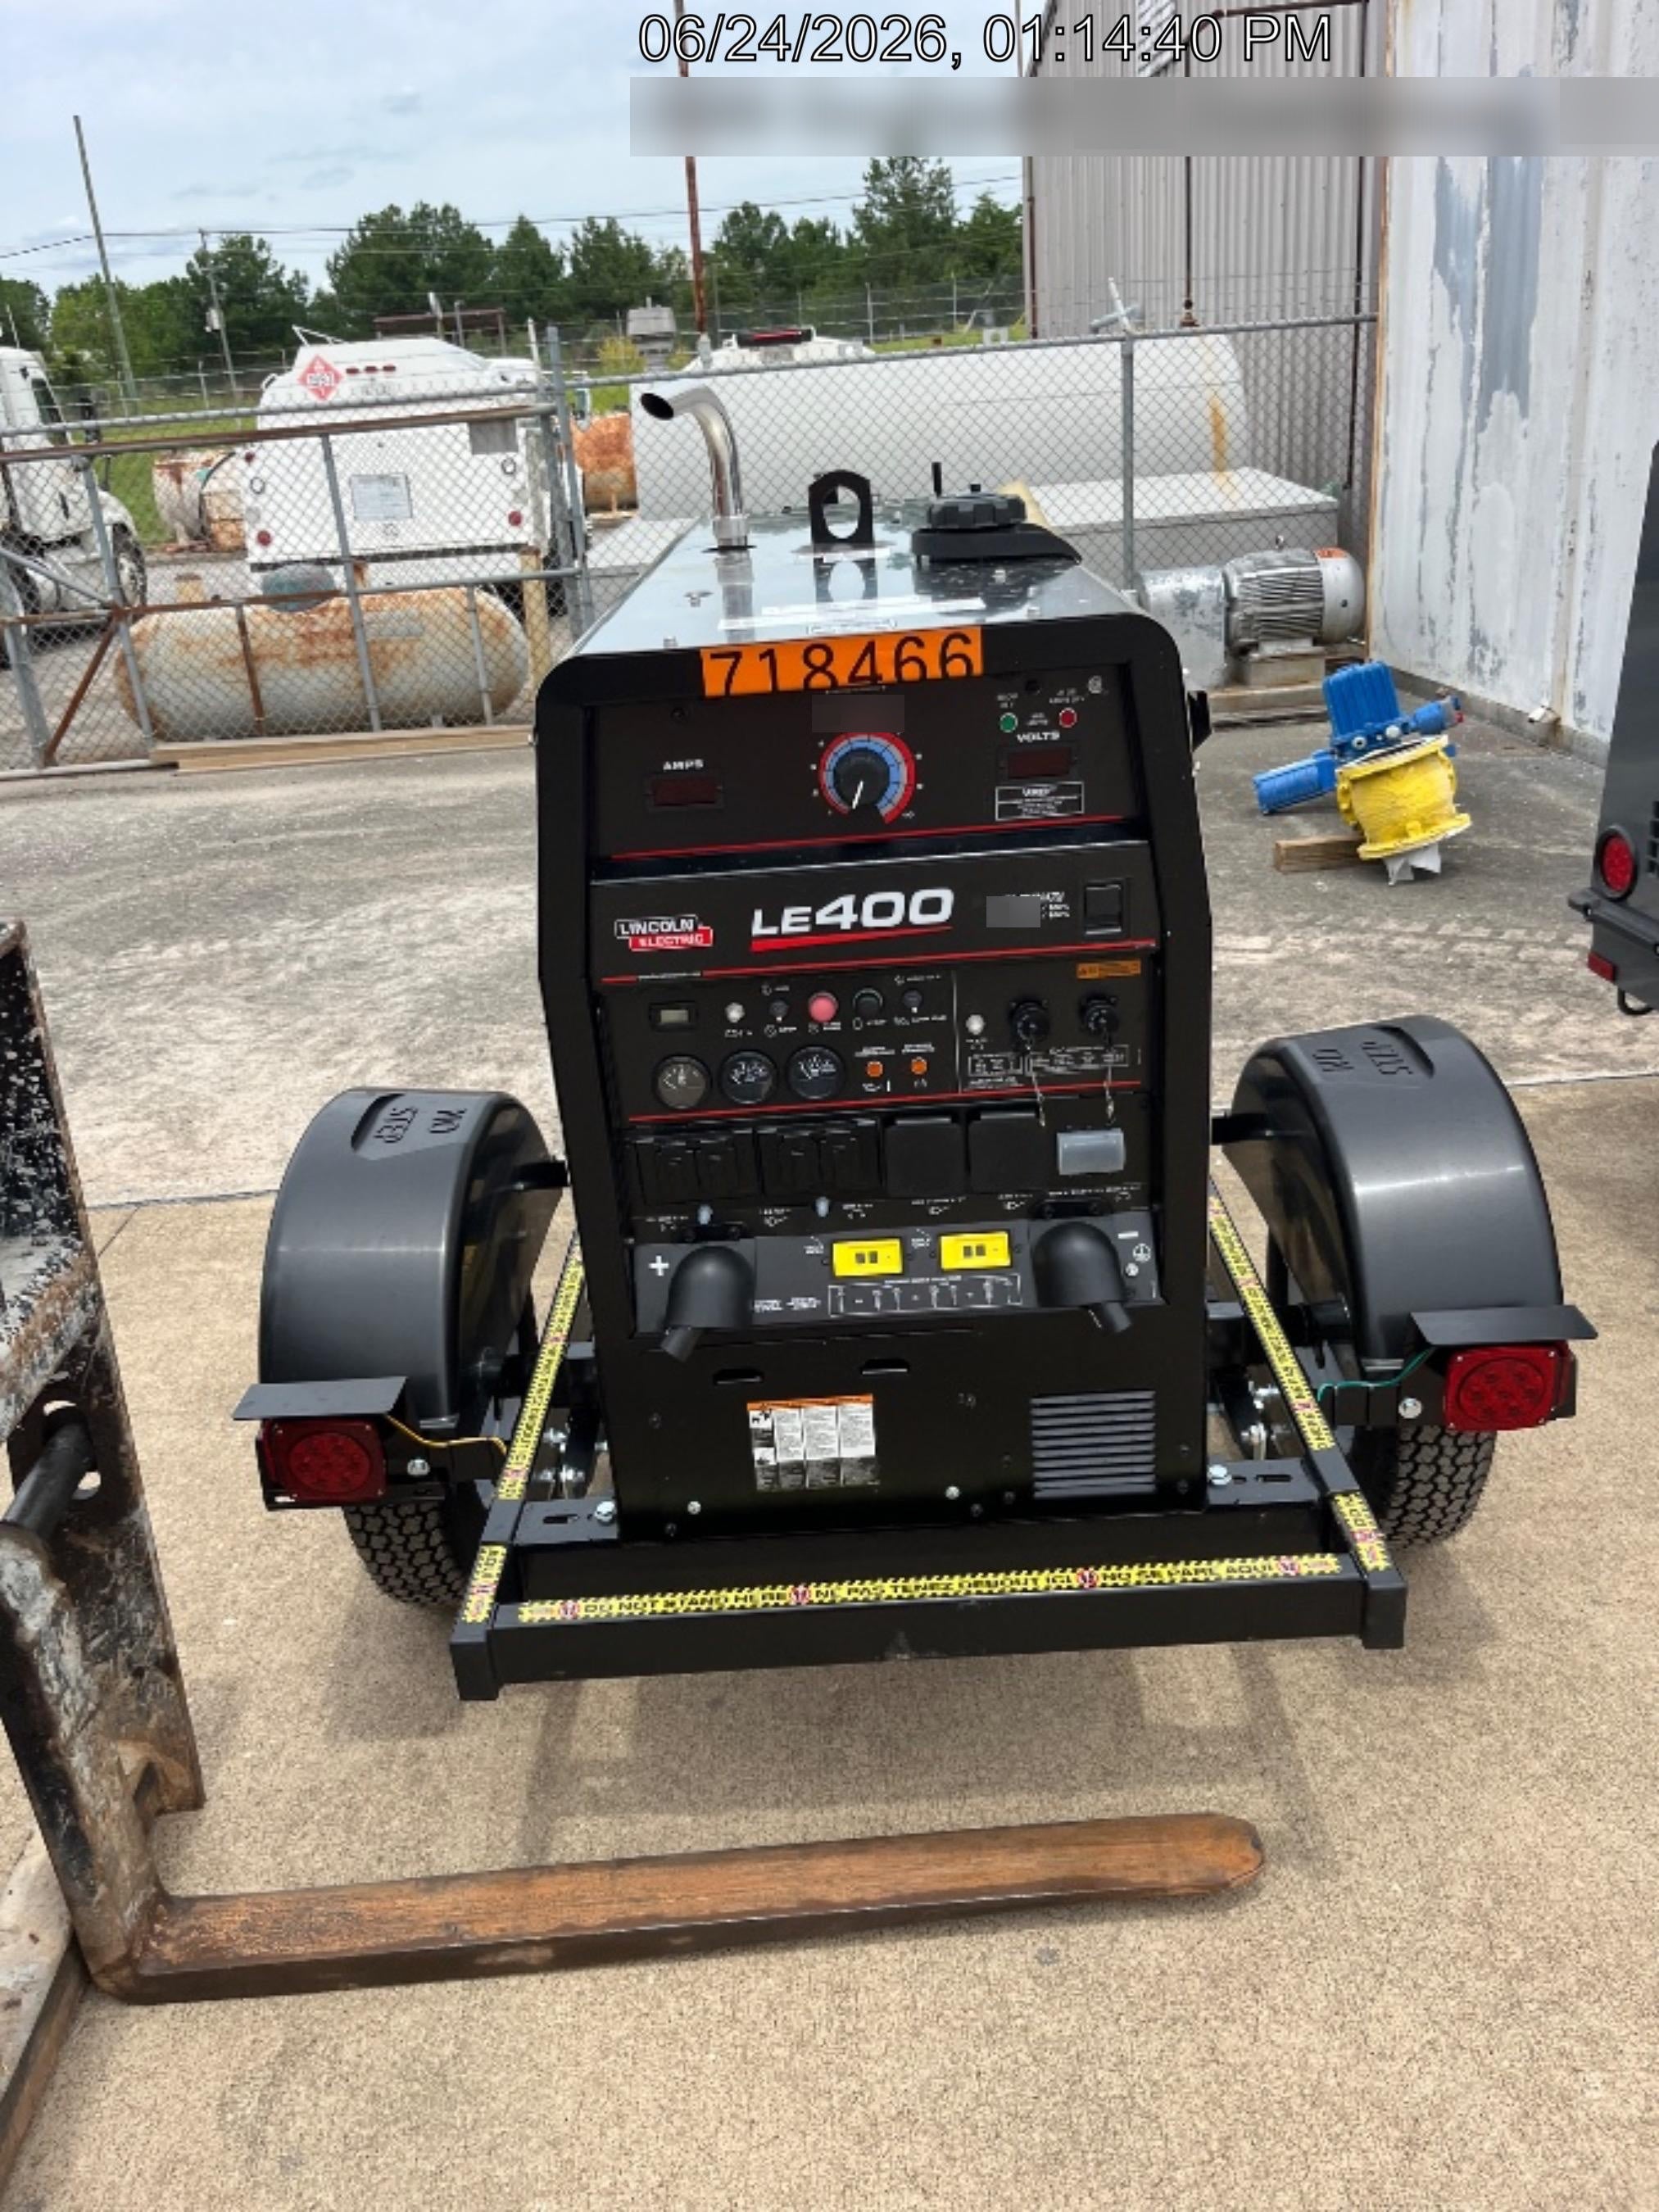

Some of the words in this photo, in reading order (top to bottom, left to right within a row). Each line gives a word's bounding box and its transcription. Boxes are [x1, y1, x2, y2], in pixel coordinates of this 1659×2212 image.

[709, 632, 973, 696] 718466
[1017, 730, 1060, 743] VOLTS
[663, 758, 704, 771] AMPS
[751, 887, 954, 937] LE400
[619, 918, 694, 935] LINCOLN
[638, 933, 704, 947] ELECTRIC
